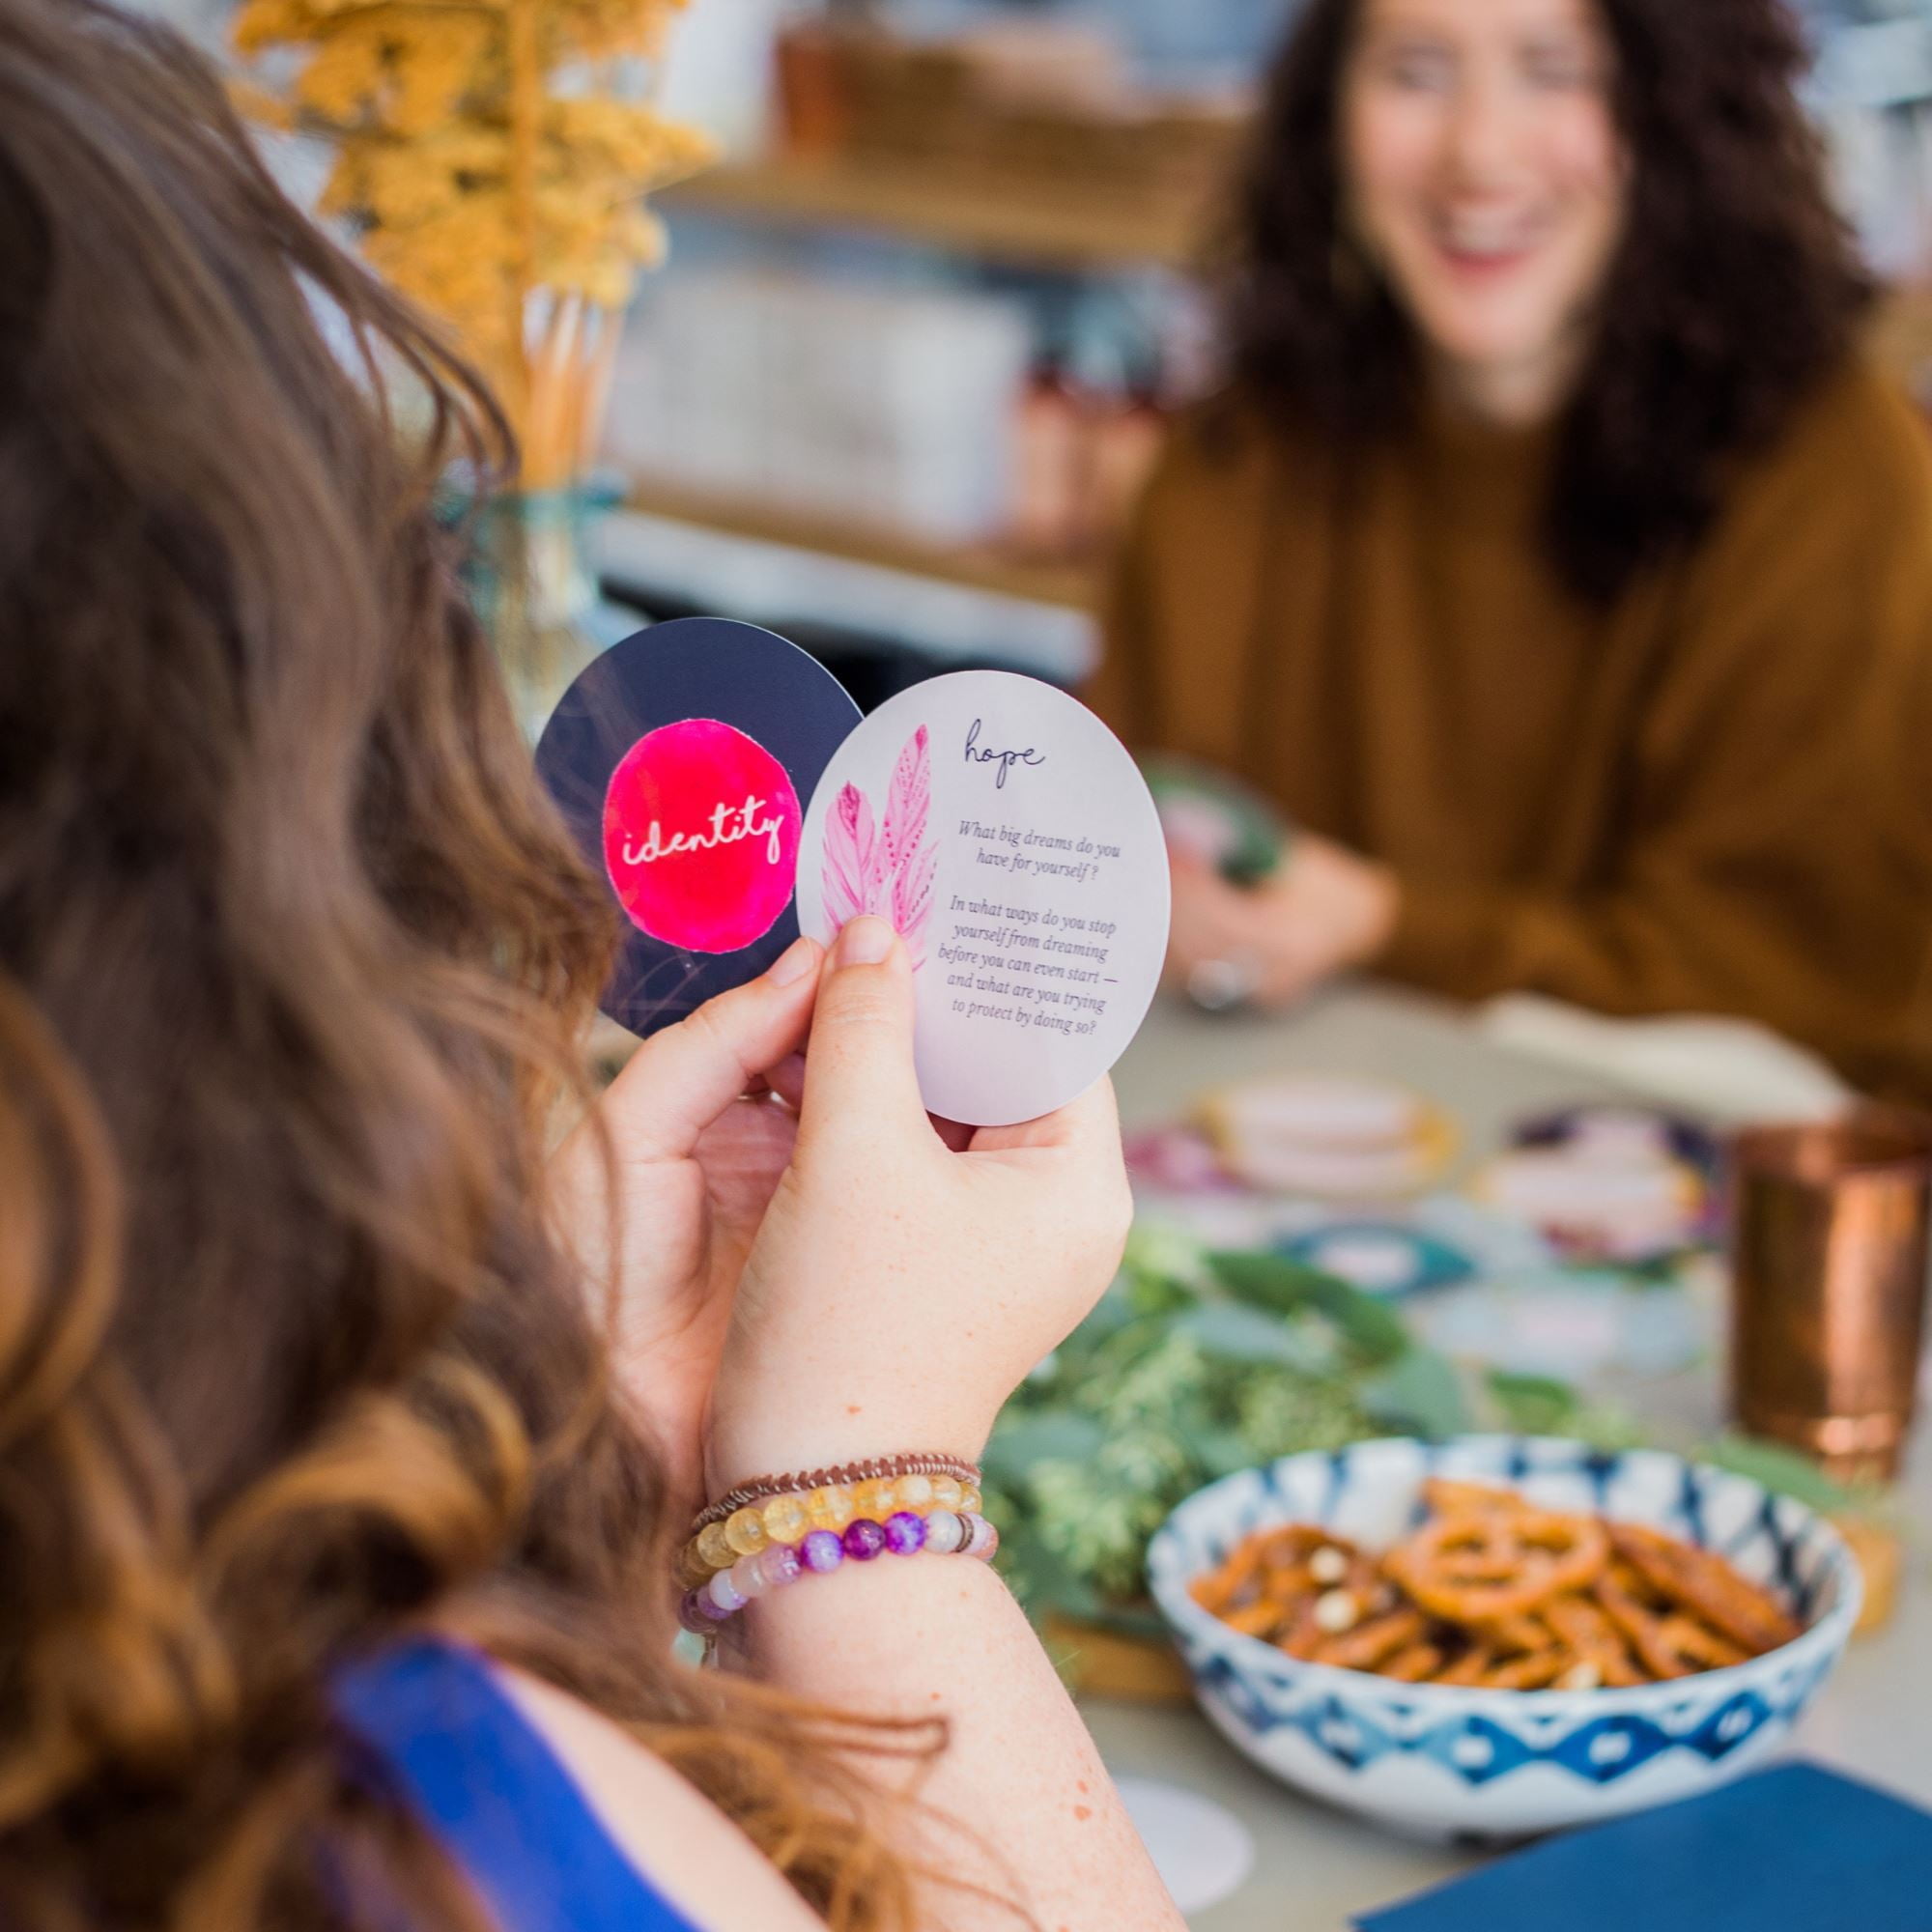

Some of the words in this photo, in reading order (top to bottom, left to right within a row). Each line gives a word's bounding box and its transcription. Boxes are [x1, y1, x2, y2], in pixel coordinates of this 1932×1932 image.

[964, 718, 1047, 789] hope
[622, 795, 785, 867] identity
[959, 820, 996, 839] What
[999, 825, 1019, 847] big
[1024, 829, 1072, 851] dreams
[1076, 838, 1094, 854] do
[1094, 844, 1121, 859] you
[976, 847, 1009, 867] have
[1009, 854, 1032, 872] for
[951, 895, 965, 910] In
[968, 899, 1003, 918] what
[1007, 908, 1039, 923] ways
[1042, 909, 1059, 925] do
[1061, 917, 1085, 930] you
[1090, 921, 1116, 939] stop
[938, 943, 979, 964] before
[980, 955, 1004, 969] you
[1007, 958, 1031, 973] can
[1034, 964, 1065, 978] even
[1067, 968, 1099, 983] start
[952, 923, 1009, 947] yourself
[1008, 927, 1040, 948] from
[1042, 935, 1109, 963] dreaming
[947, 972, 974, 988] and
[977, 976, 1009, 995] what
[1012, 986, 1034, 998] are
[1035, 989, 1060, 1005] you
[1064, 992, 1106, 1014] trying
[952, 998, 965, 1011] to
[967, 1001, 1012, 1018] protect
[1015, 1007, 1032, 1027] by
[1034, 1012, 1073, 1036] doing
[1076, 1020, 1097, 1036] so?
